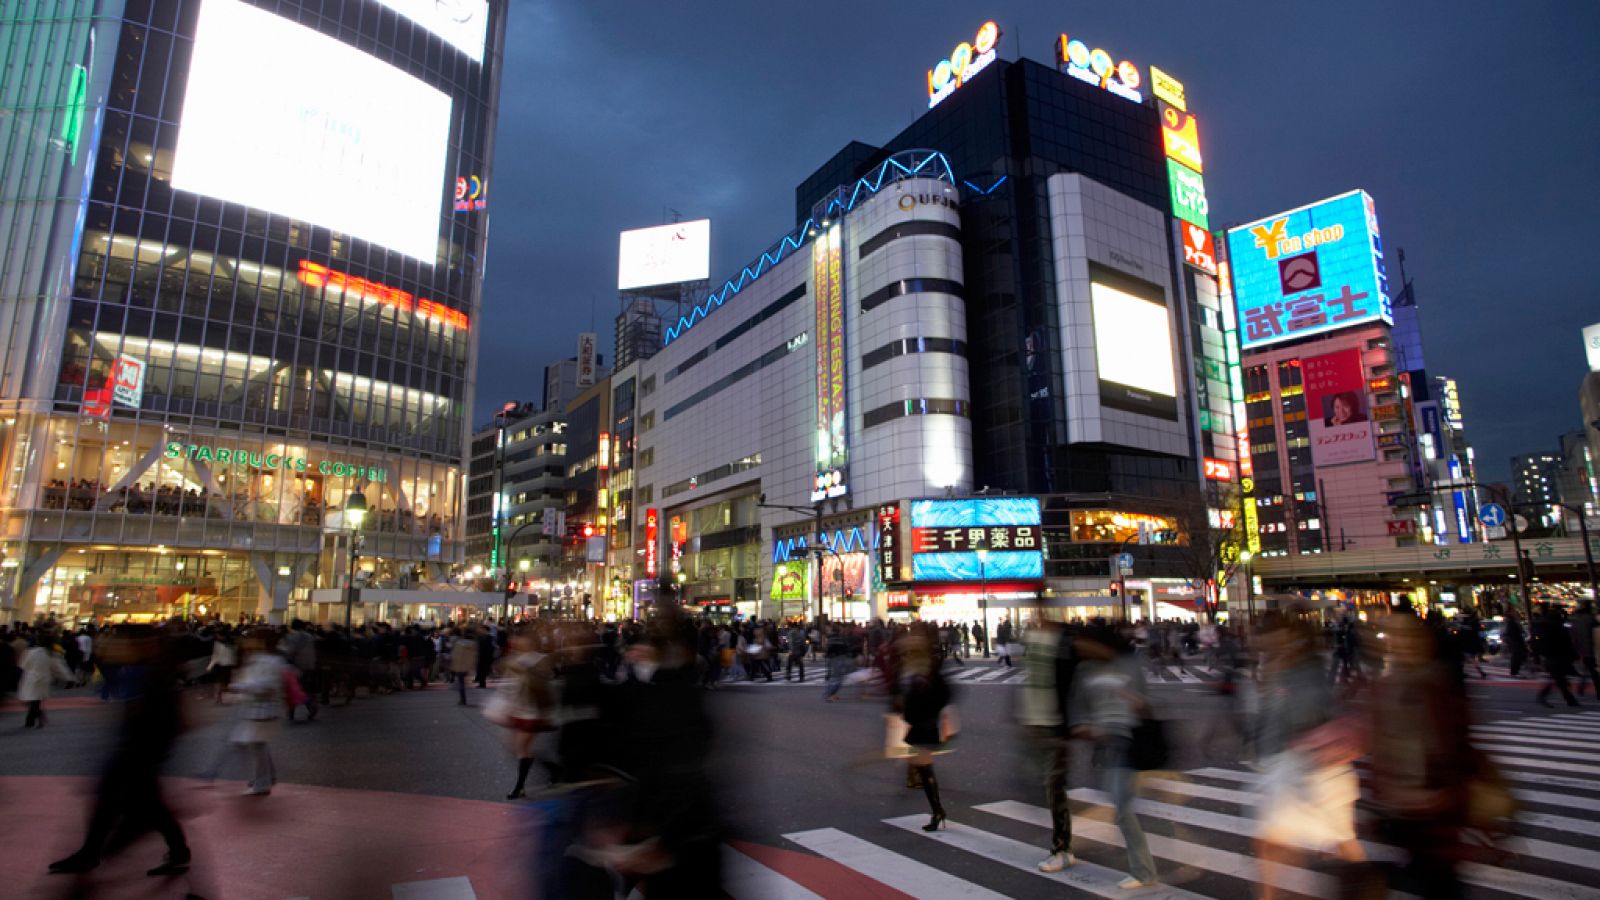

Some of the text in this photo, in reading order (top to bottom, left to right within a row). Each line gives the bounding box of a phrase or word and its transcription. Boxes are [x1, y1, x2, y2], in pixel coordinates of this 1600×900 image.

[1303, 224, 1345, 249] shop
[1245, 286, 1369, 341] 武富士
[830, 260, 843, 398] SPRING FESTA
[166, 442, 307, 472] STARBUCKS
[919, 527, 1036, 549] 三千里薬品
[1433, 548, 1451, 560] JR
